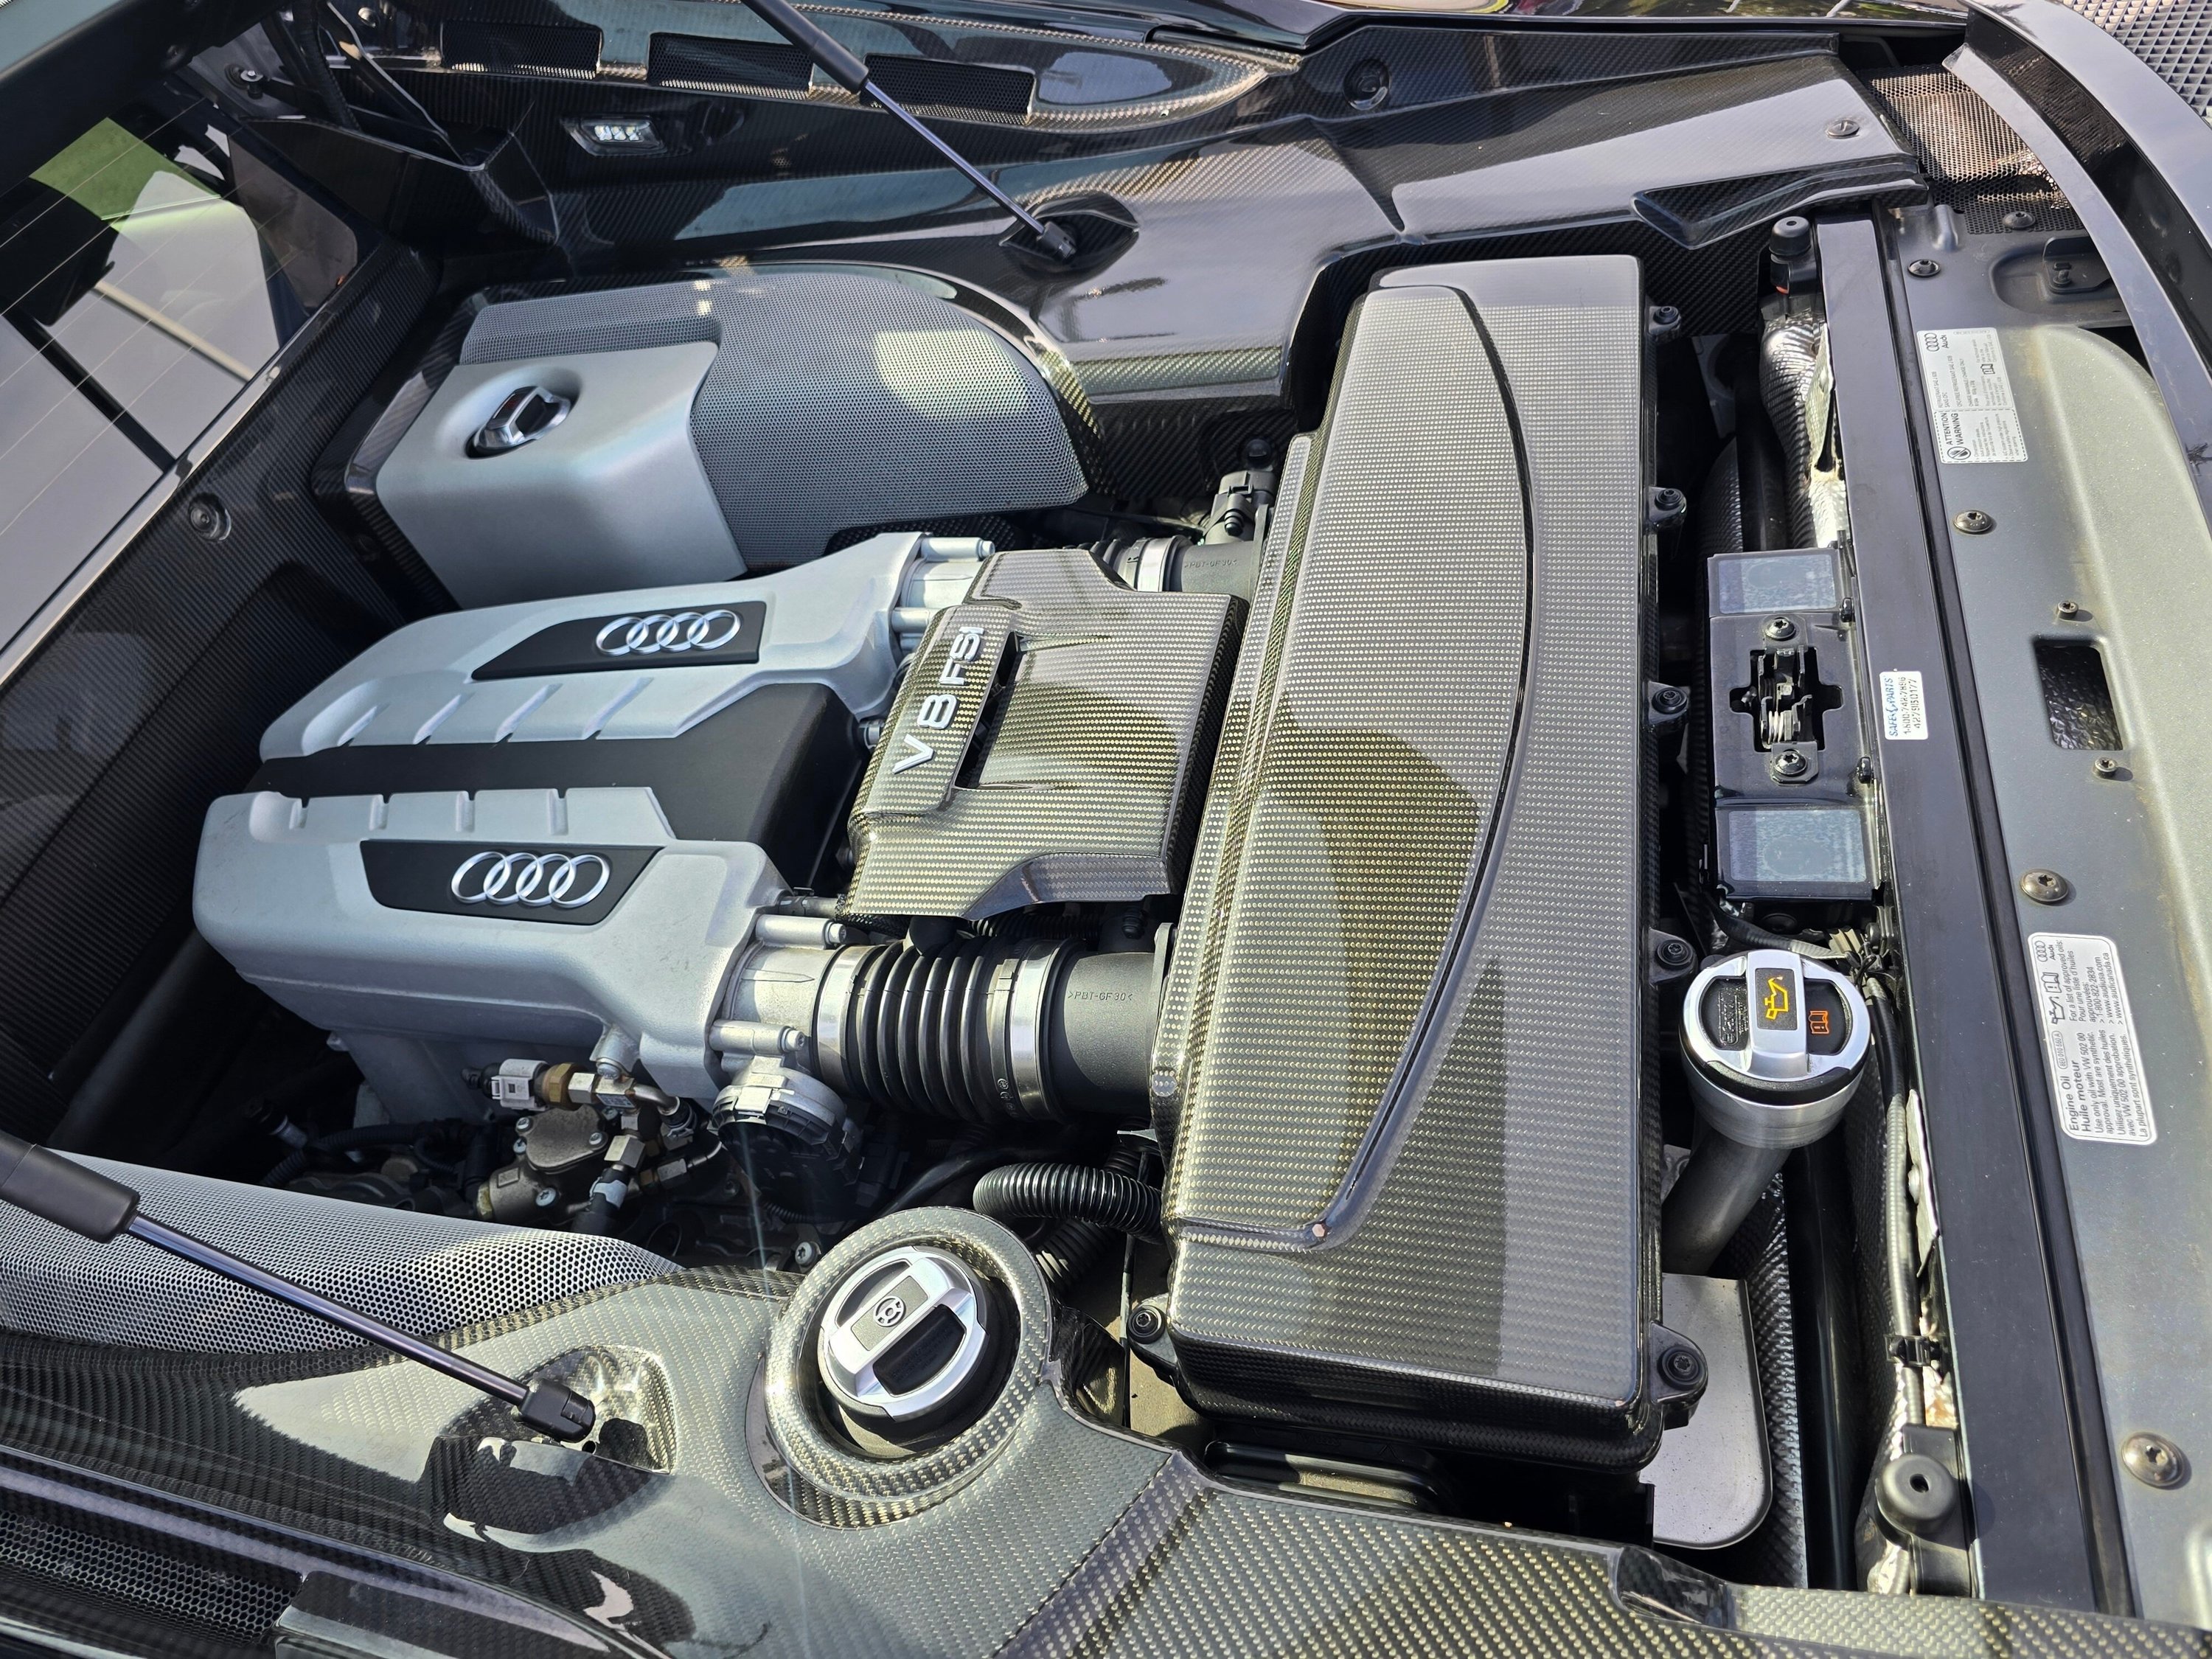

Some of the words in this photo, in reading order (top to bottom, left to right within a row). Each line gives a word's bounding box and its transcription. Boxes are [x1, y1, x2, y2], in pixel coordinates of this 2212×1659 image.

[1939, 335, 1949, 348] Audi
[1941, 413, 1952, 445] ATTENTION
[1951, 413, 1964, 445] WARNING
[1885, 678, 1895, 703] PARTS
[892, 694, 959, 774] V8
[939, 626, 985, 686] FSI
[2048, 945, 2056, 960] Audi
[2055, 940, 2064, 952] oils:
[2058, 953, 2071, 984] approved
[2067, 950, 2077, 975] d'huiles
[2072, 977, 2080, 990] liste
[2087, 967, 2103, 1016] 1-800-822-2834
[2095, 957, 2112, 1018] www.audiusa.com
[2103, 953, 2121, 1018] www.audicanada.ca
[1068, 991, 1133, 1001] >PBT-GF30<
[2066, 993, 2074, 1003] list
[2076, 992, 2084, 1004] une
[2082, 982, 2096, 1022] approuvées:
[2069, 1009, 2077, 1020] For
[2076, 1032, 2085, 1041] 00
[2098, 1029, 2108, 1049] huiles
[2079, 1043, 2088, 1055] 502
[2087, 1032, 2099, 1064] synthetic.
[2109, 1034, 2124, 1077] approbation.
[2081, 1057, 2091, 1070] VW
[2103, 1051, 2111, 1063] des
[2120, 1034, 2135, 1080] synthétiques.
[2094, 1066, 2102, 1077] are
[2060, 1076, 2071, 1090] Oil
[2072, 1060, 2085, 1100] moteur
[2084, 1072, 2095, 1088] with
[2096, 1079, 2106, 1097] Most
[2106, 1065, 2121, 1107] uniquement
[2116, 1079, 2126, 1088] 00
[2087, 1089, 2097, 1099] oil
[2119, 1089, 2129, 1102] 502
[2129, 1082, 2139, 1098] sont
[2066, 1094, 2079, 1130] Engine
[2091, 1100, 2101, 1116] only
[2121, 1103, 2132, 1116] VW
[2133, 1100, 2146, 1126] plupart
[2078, 1105, 2091, 1132] Huile
[2100, 1100, 2113, 1133] approval.
[2115, 1110, 2126, 1135] Utilisez
[2094, 1119, 2104, 1133] Use
[2126, 1119, 2136, 1136] avec
[2139, 1128, 2148, 1137] La
